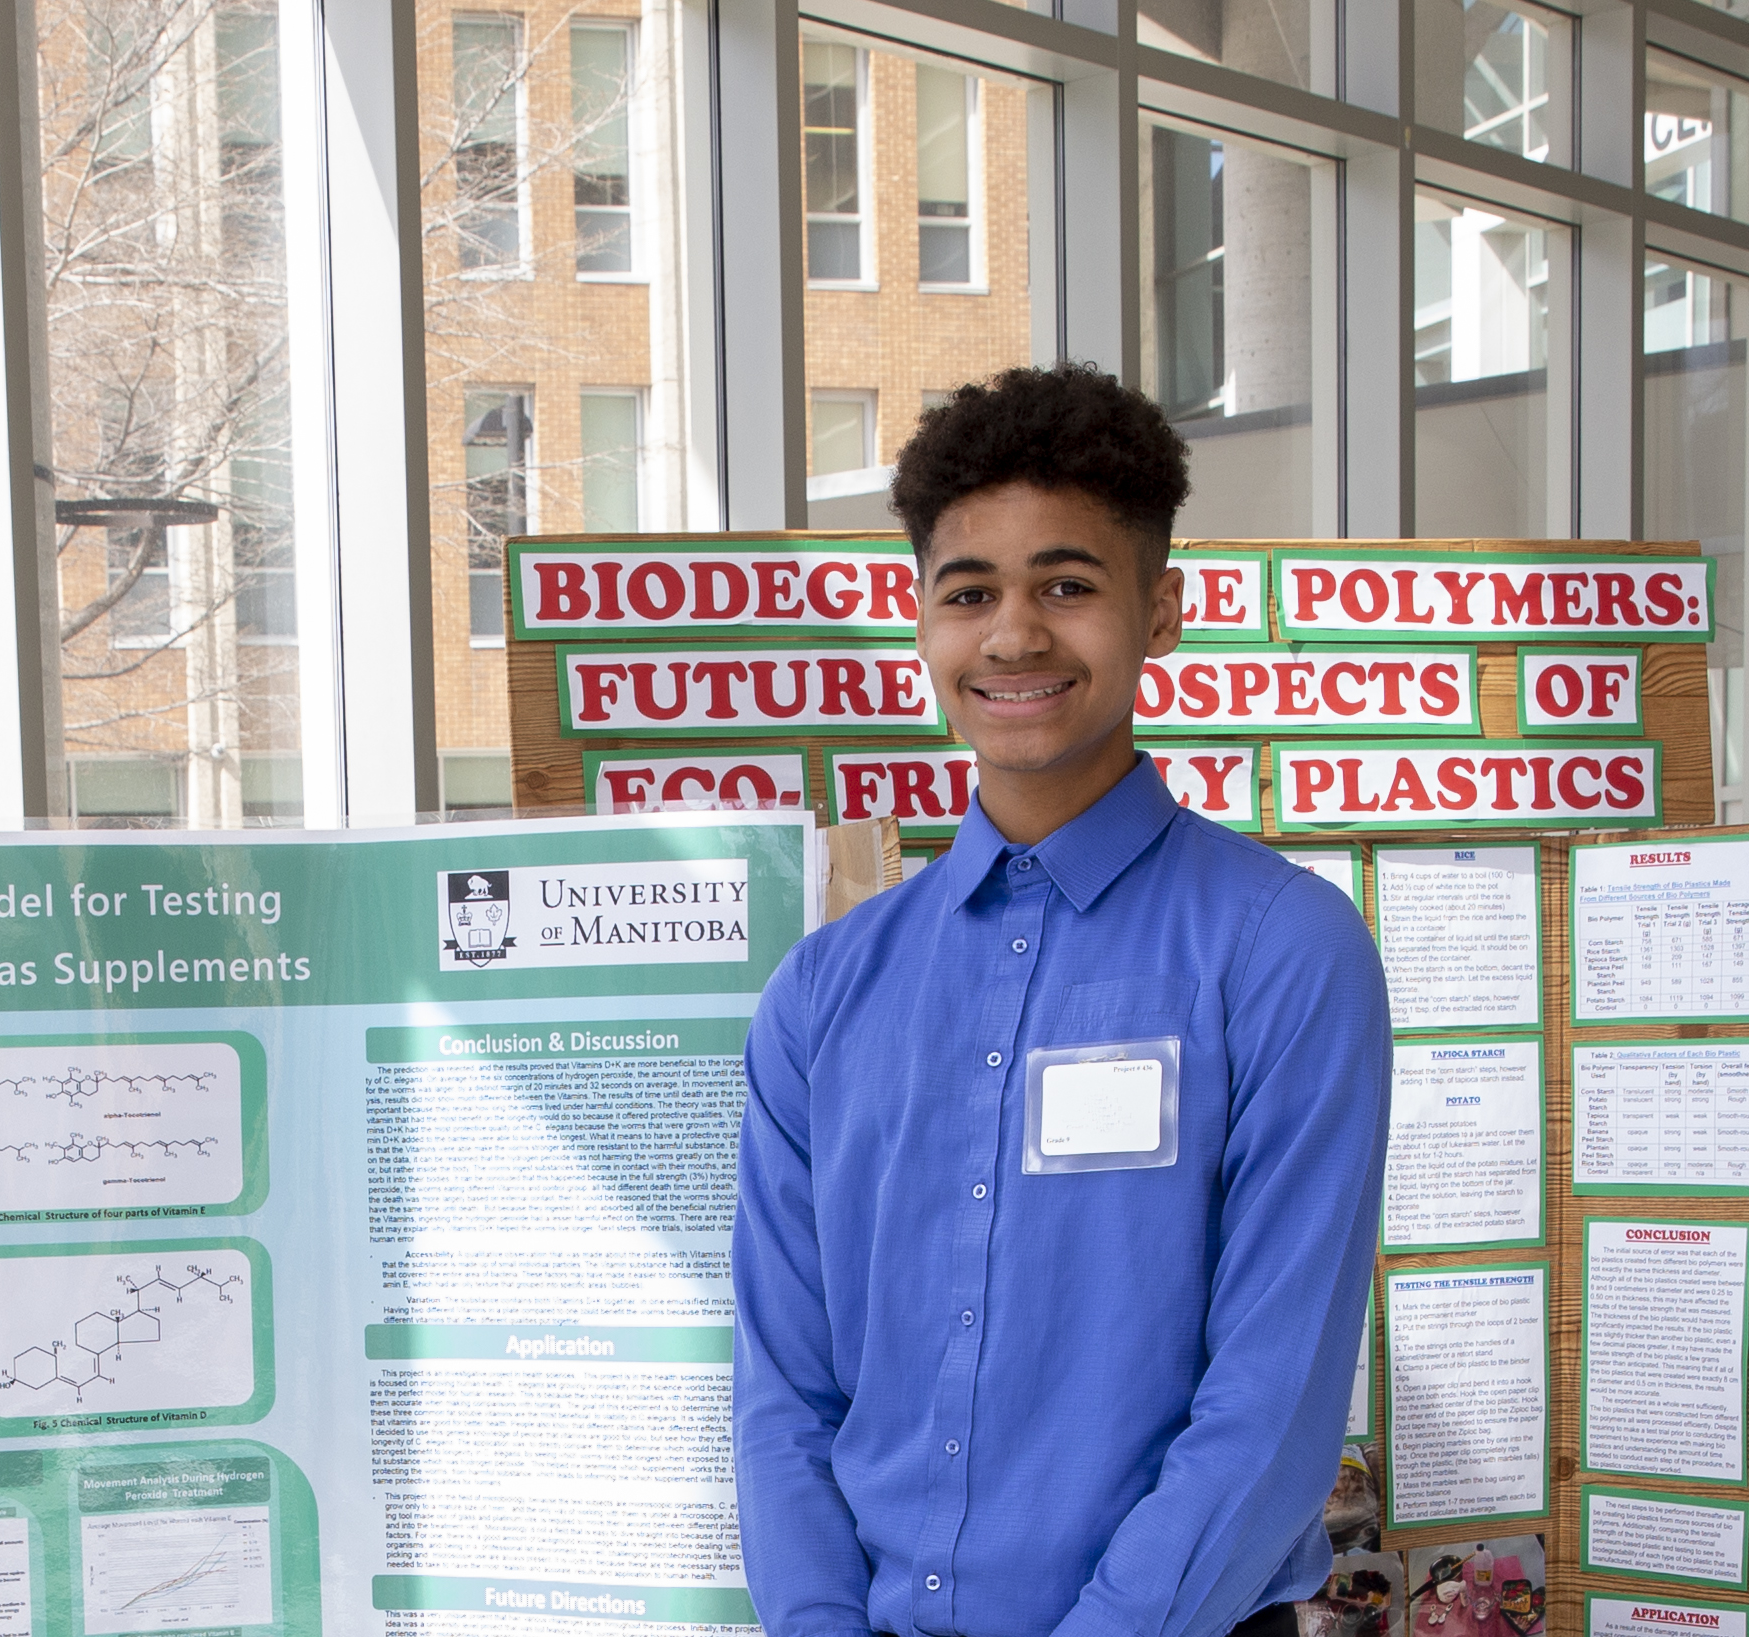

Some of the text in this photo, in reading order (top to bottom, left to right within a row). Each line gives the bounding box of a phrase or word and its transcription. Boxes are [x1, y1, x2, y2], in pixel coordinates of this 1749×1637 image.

[534, 561, 1246, 623] BIODEGRE
[1291, 567, 1701, 626] POLYMERS:
[576, 658, 925, 721] FUTURE
[1134, 662, 1459, 718] OSPECTS
[1535, 664, 1628, 717] OF
[604, 764, 800, 810] ECO-
[1290, 756, 1644, 812] PLASTICS
[1454, 851, 1475, 860] RICE
[1630, 851, 1691, 864] RESULTS
[70, 882, 126, 921] for
[141, 882, 280, 924] Testing
[539, 879, 747, 908] UNIVERSITY
[541, 926, 562, 939] OF
[570, 915, 747, 945] MANITOBA
[54, 950, 310, 992] Supplements
[438, 1030, 678, 1056] Conclusion & Discussion
[1431, 1048, 1504, 1058] TAPIOCA STARCH
[1446, 1096, 1480, 1105] POTATO
[45, 1211, 89, 1220] Structure
[91, 1209, 101, 1218] of
[103, 1209, 122, 1217] four
[125, 1209, 148, 1219] parts
[150, 1207, 160, 1216] of
[162, 1206, 198, 1215] Vitamin
[200, 1206, 205, 1214] E
[1625, 1229, 1710, 1241] CONCLUSION
[1394, 1275, 1534, 1290] TESTING THE TENSILE STRENGTH
[505, 1334, 615, 1359] Application
[84, 1471, 264, 1489] Movement Analysis During Hydrogen
[125, 1487, 223, 1500] Peroxide Treatment
[485, 1587, 646, 1616] Future Directions
[1631, 1607, 1719, 1626] APPLICATION
